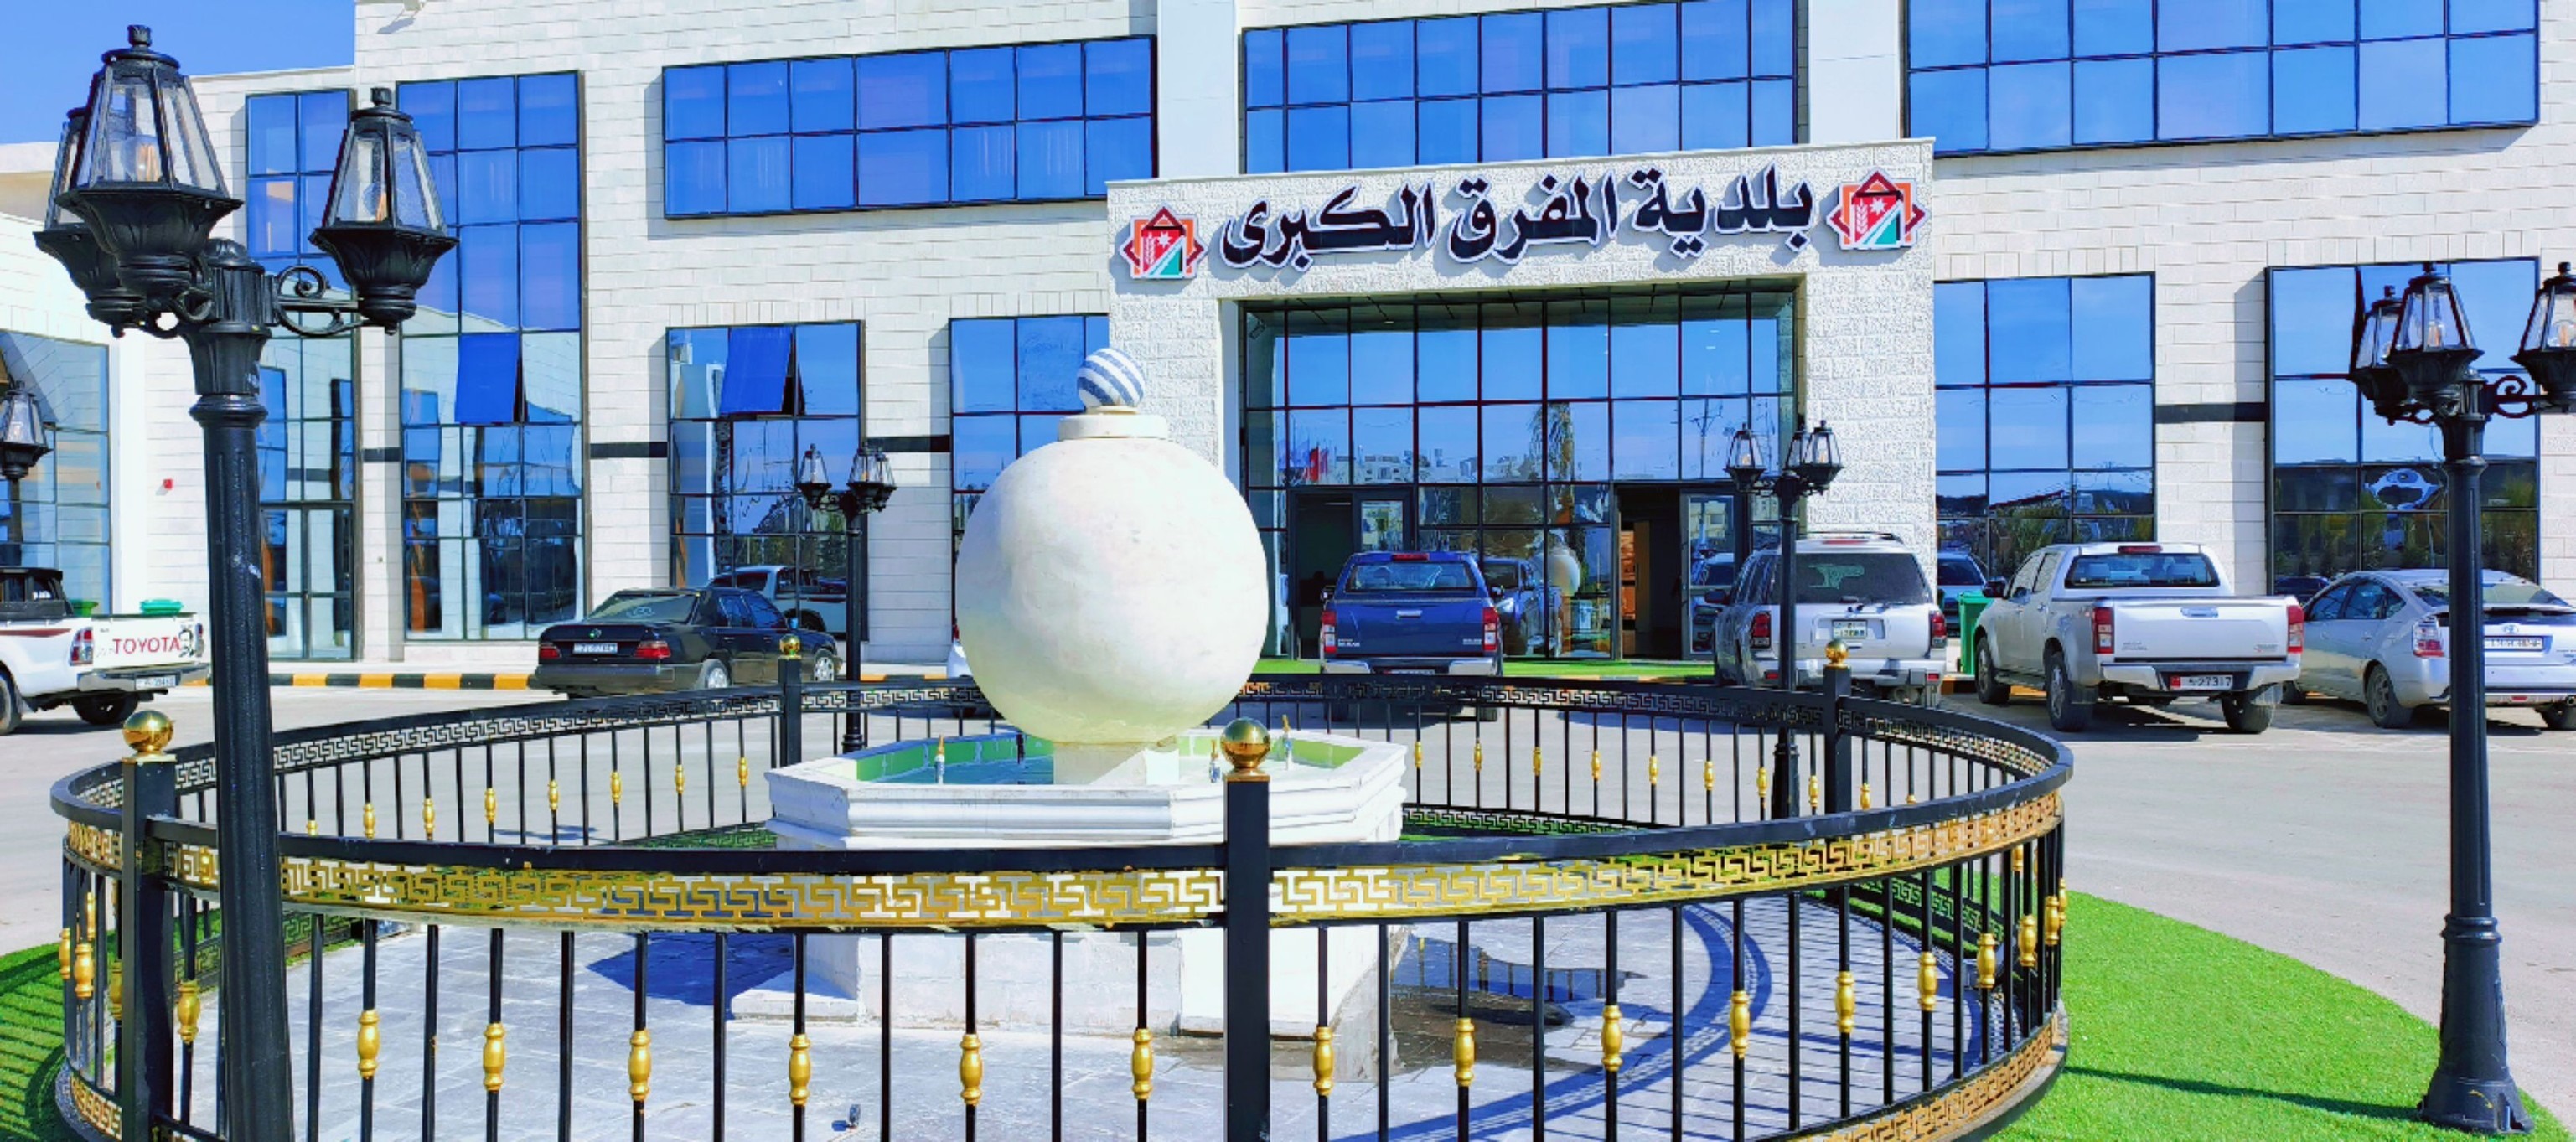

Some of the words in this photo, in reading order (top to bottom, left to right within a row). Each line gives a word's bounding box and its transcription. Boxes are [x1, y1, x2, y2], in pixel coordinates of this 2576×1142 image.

[1221, 179, 1435, 271] الكبرى
[1448, 169, 1618, 266] المفرق
[1628, 160, 1814, 258] بلدية
[112, 636, 180, 654] TOYOTA
